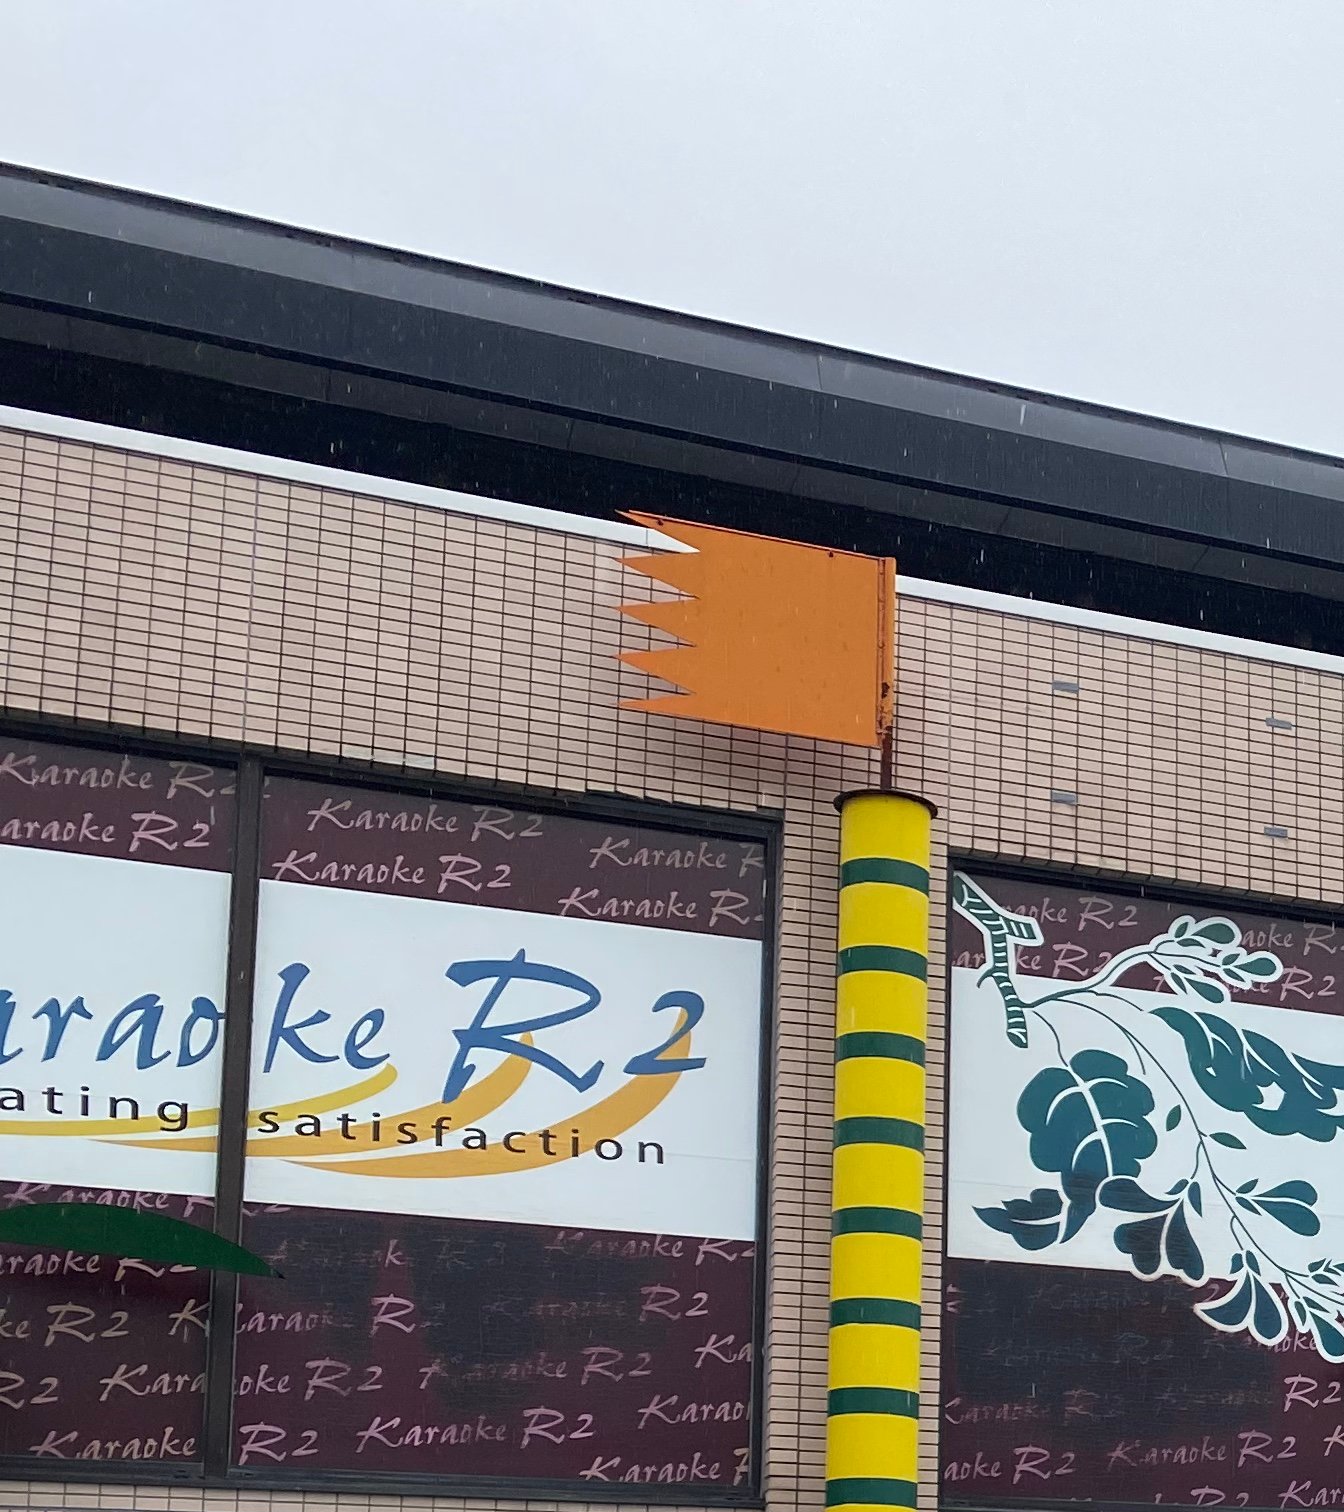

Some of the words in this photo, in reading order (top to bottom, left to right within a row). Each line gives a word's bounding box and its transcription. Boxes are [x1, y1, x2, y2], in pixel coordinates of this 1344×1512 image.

[0, 752, 153, 790] Karaoke
[0, 812, 116, 843] araoke
[129, 810, 209, 852] R2
[308, 798, 459, 833] Karaoke
[471, 805, 543, 842] R2
[589, 836, 727, 869] Karaoke
[272, 850, 425, 885] Karaoke
[437, 854, 511, 895] R2
[558, 886, 697, 920] Karaoke
[1078, 896, 1139, 931] R2
[1280, 966, 1337, 1002] R2
[441, 948, 706, 1103] R2
[257, 1107, 665, 1165] satisfaction
[639, 1283, 708, 1321] R2
[45, 1302, 128, 1346] R2
[305, 1357, 383, 1400] R2
[581, 1347, 651, 1385] R2
[1283, 1374, 1341, 1412] R2
[30, 1427, 196, 1460] Karaoke
[239, 1421, 318, 1466] R2
[356, 1416, 506, 1453] Karaoke
[521, 1405, 597, 1449] R2
[1106, 1437, 1227, 1468] Karaoke
[1237, 1429, 1298, 1468] R2
[580, 1452, 721, 1484] Karaoke
[1012, 1444, 1078, 1485] R2
